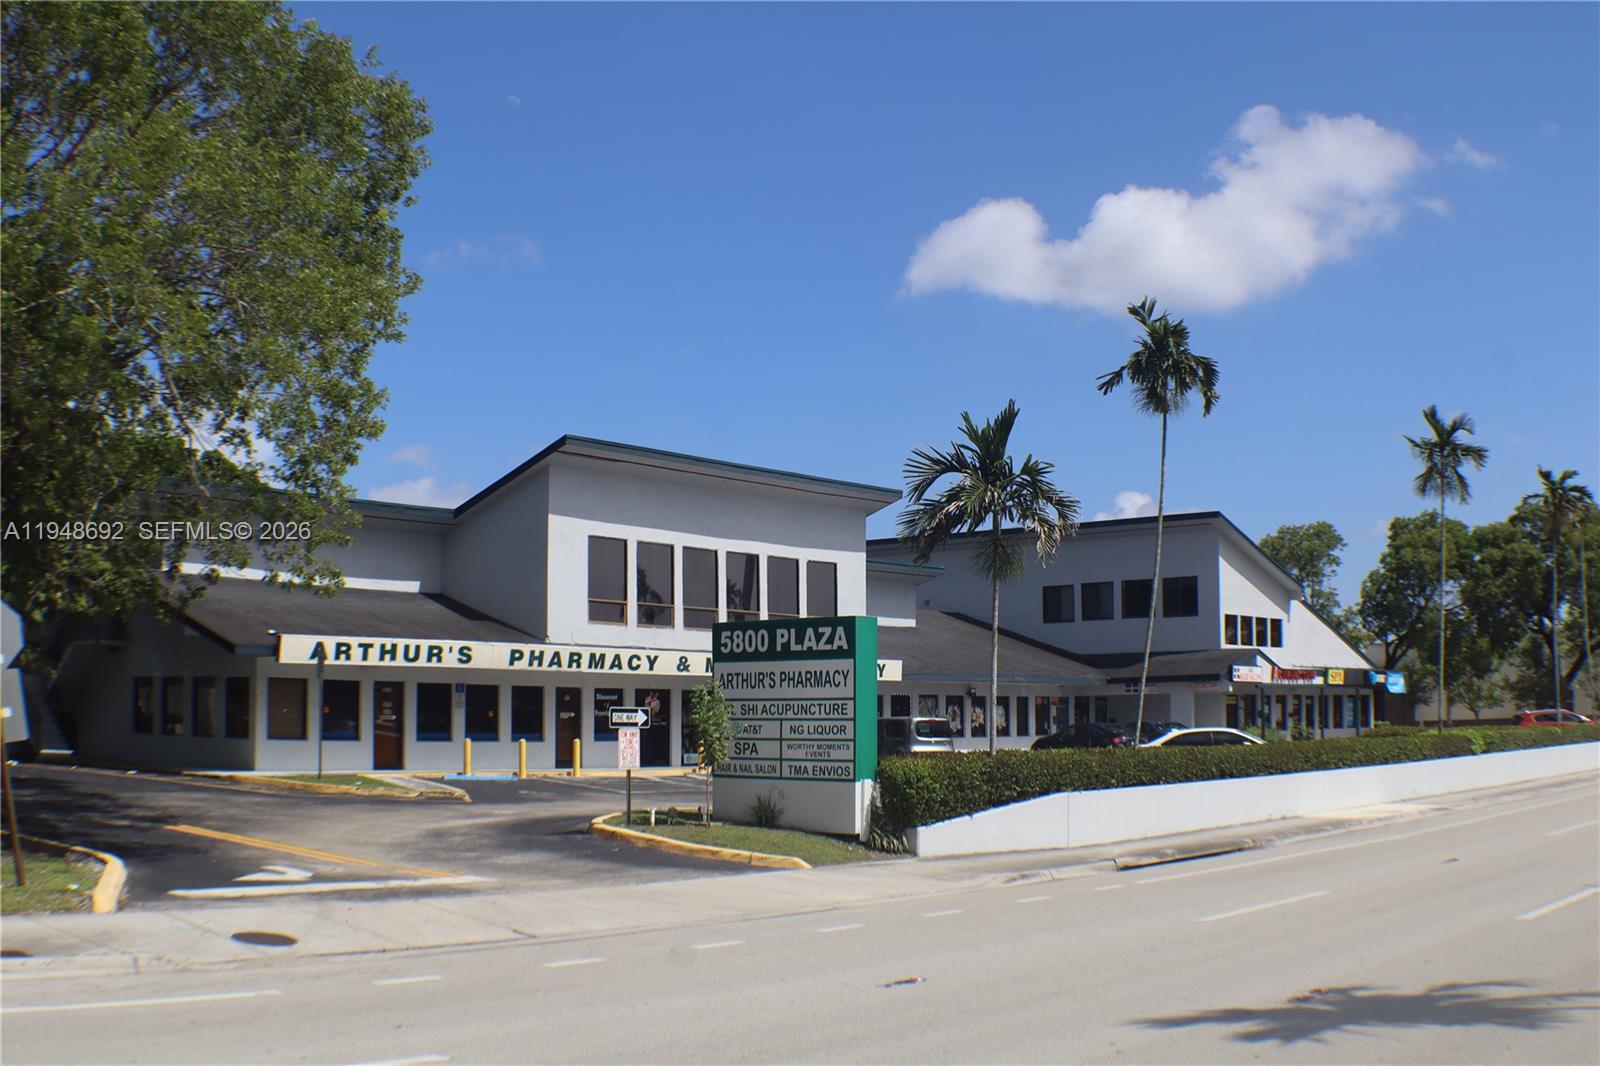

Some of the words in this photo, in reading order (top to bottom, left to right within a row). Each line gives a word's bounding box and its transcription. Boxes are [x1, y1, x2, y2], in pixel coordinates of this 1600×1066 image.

[720, 629, 769, 654] 5800
[776, 626, 848, 652] PLAZA
[310, 641, 473, 664] ARTHUR'S
[508, 648, 659, 672] PHARMACY
[676, 655, 691, 673] &
[719, 671, 777, 690] ARTHUR'S
[780, 669, 850, 688] PHARMACY
[740, 704, 758, 716] SHI
[761, 703, 849, 716] ACUPUNCTURE
[614, 713, 624, 722] ONE
[626, 713, 637, 722] WAY
[743, 724, 763, 735] AT&T
[789, 725, 804, 735] NG
[807, 725, 847, 736] LIQUOR
[734, 742, 759, 756] SPA
[732, 764, 738, 773] &
[739, 764, 754, 774] NAIL
[755, 764, 777, 775] SALON
[788, 765, 809, 776] TMA
[812, 766, 851, 777] ENVIOS
